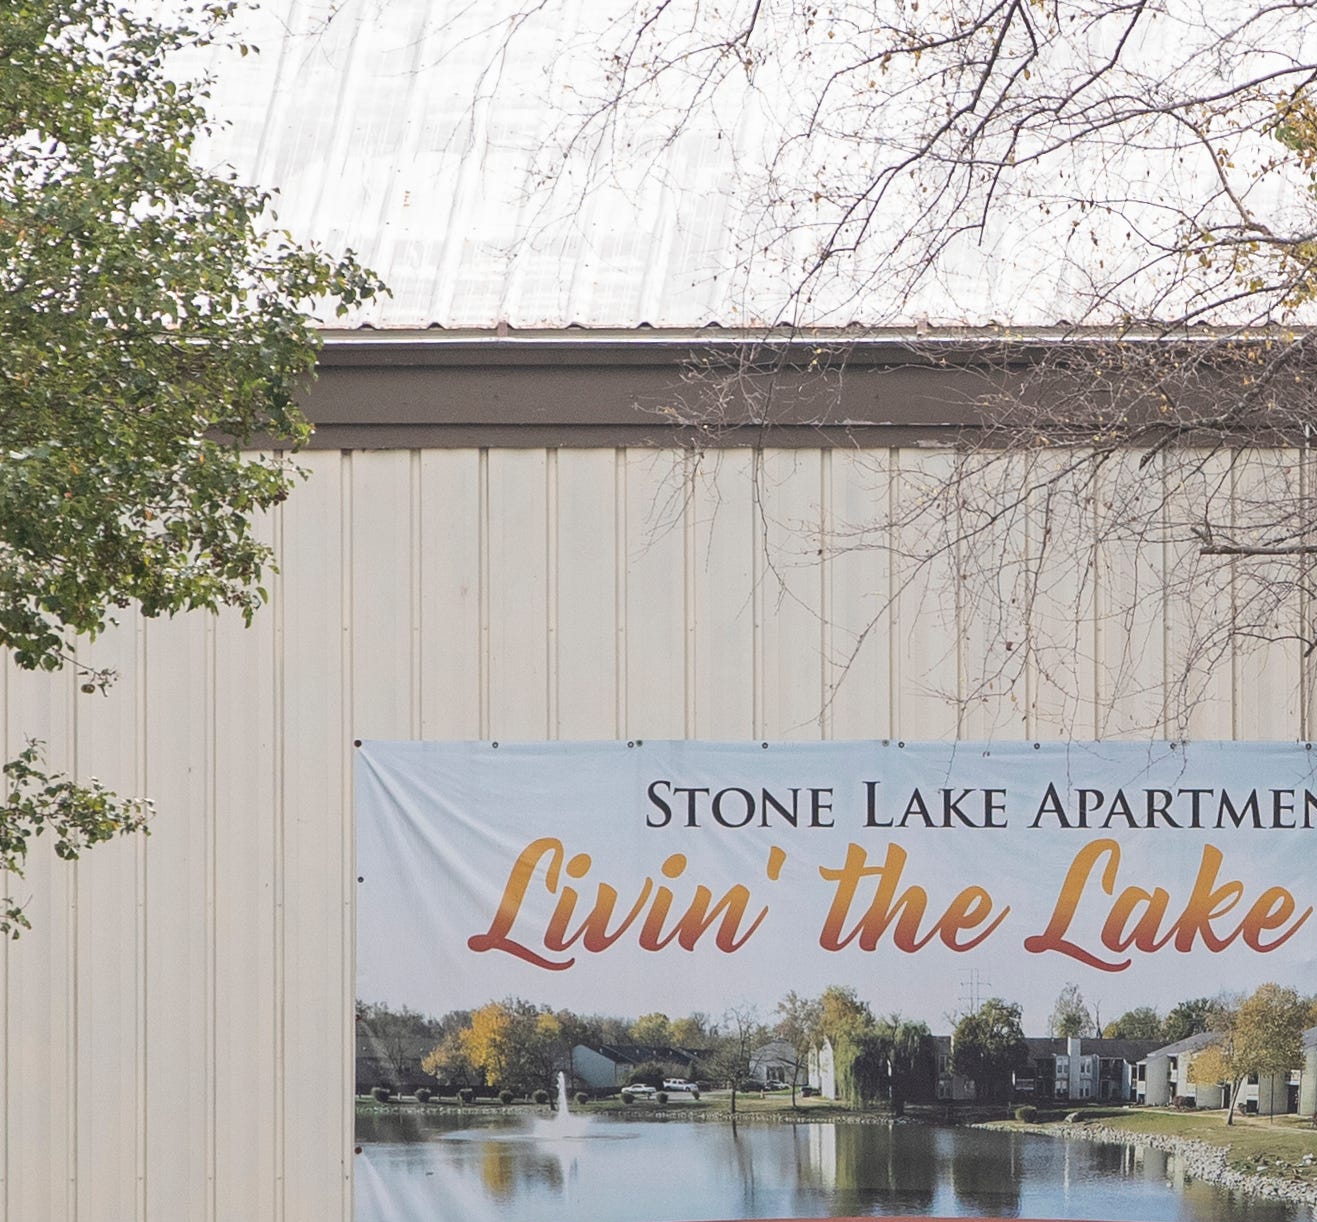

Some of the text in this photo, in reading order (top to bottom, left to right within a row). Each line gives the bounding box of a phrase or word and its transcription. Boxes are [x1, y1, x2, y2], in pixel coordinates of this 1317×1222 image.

[646, 780, 835, 829] STONE
[862, 780, 1008, 829] LAKE
[468, 837, 787, 971] Livin'
[819, 842, 1011, 953] the
[1024, 838, 1314, 973] Lake
